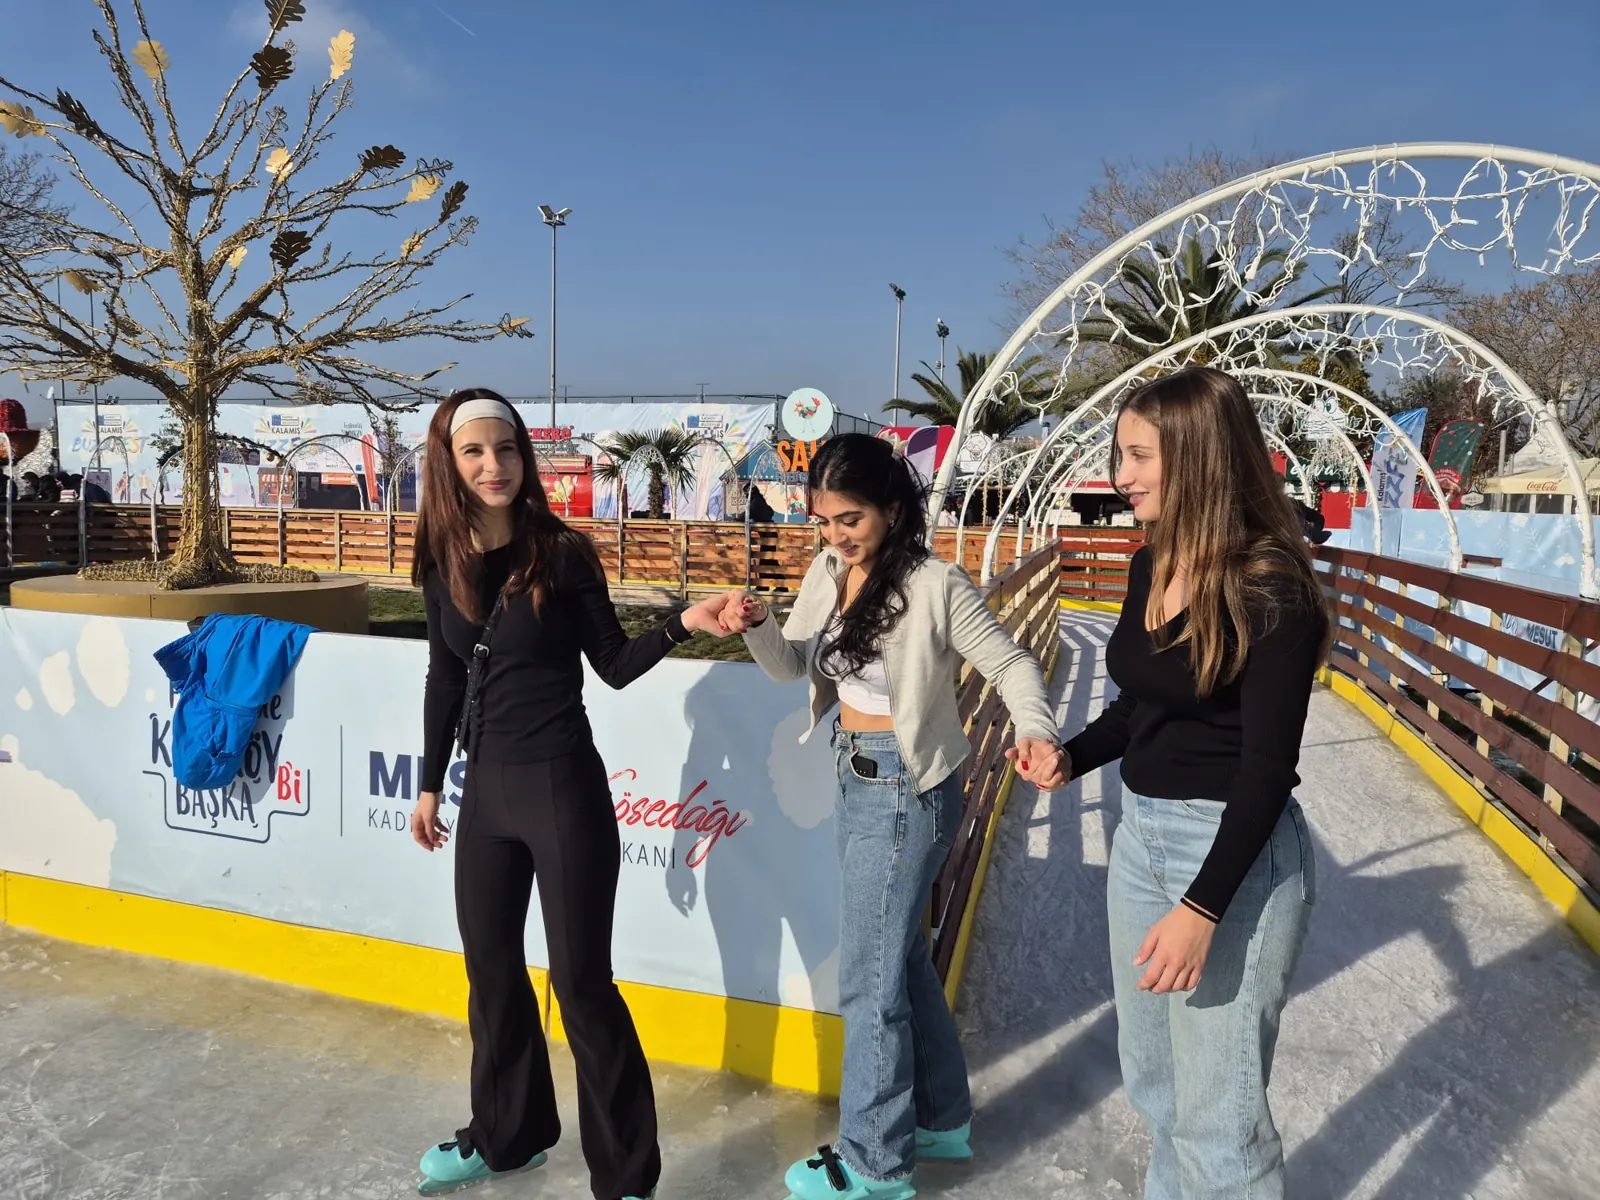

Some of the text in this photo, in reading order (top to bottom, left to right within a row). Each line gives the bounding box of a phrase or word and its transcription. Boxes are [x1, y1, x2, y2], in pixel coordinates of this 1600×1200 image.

[271, 427, 301, 435] KALAMIŞ
[1526, 622, 1558, 650] MESUT
[175, 779, 257, 829] BAŞKA
